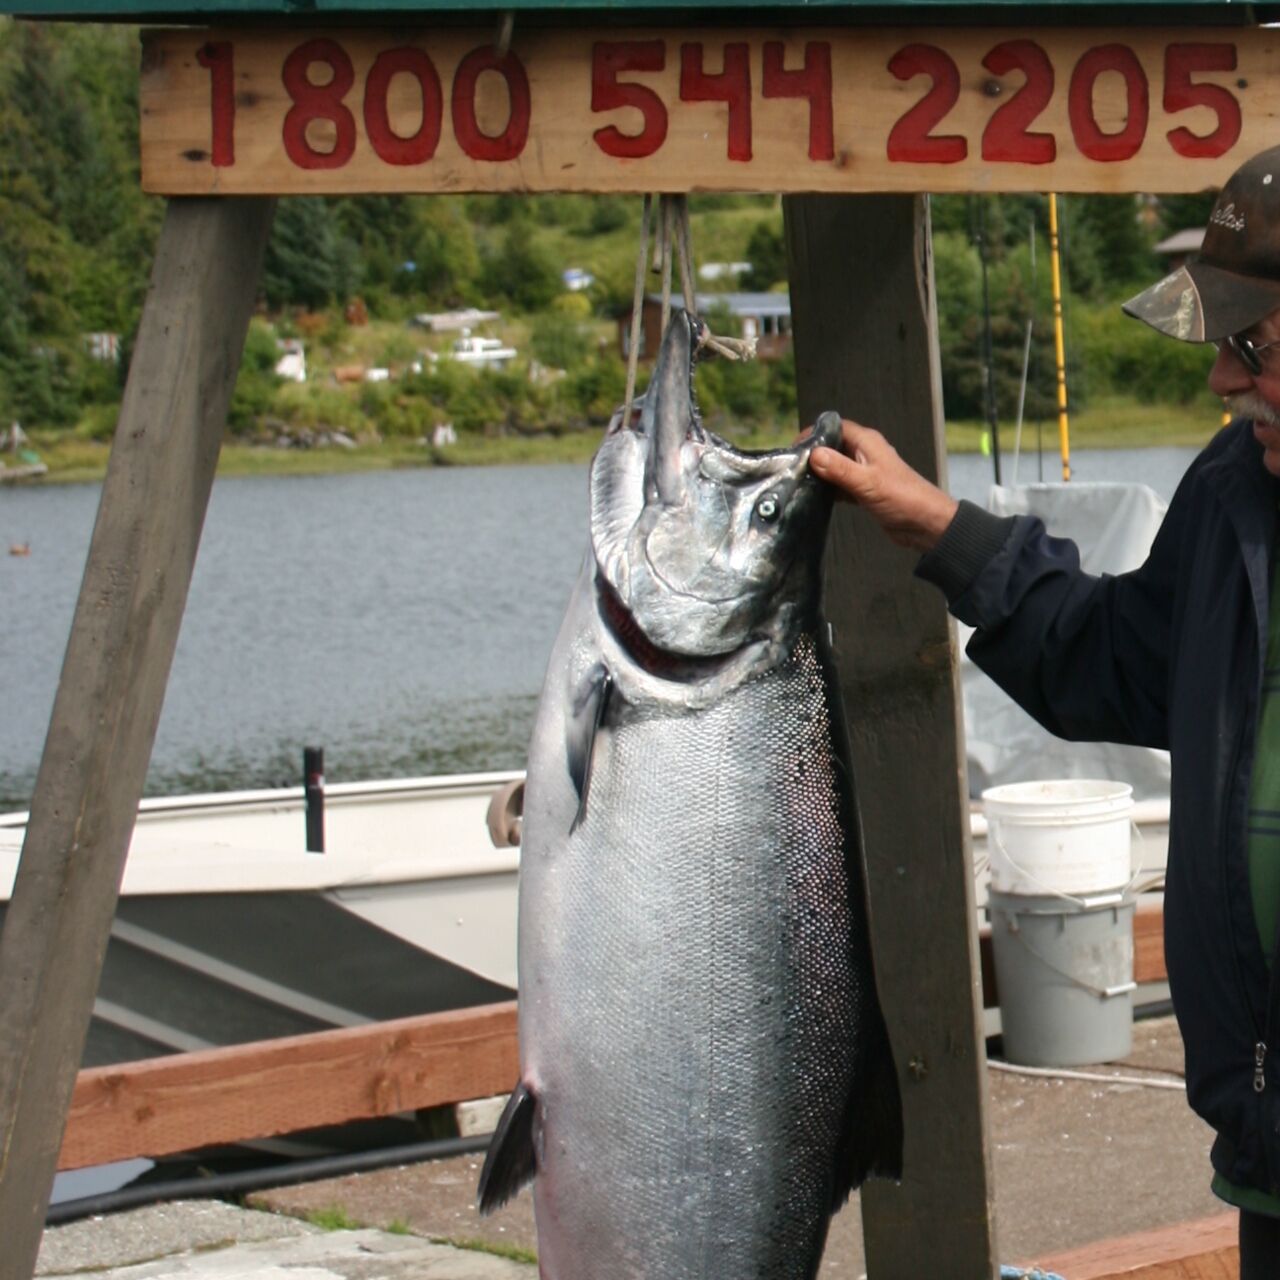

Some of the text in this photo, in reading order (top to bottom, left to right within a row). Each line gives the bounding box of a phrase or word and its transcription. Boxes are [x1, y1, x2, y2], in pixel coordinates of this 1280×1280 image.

[198, 38, 1244, 171] 1 800 544 2205
